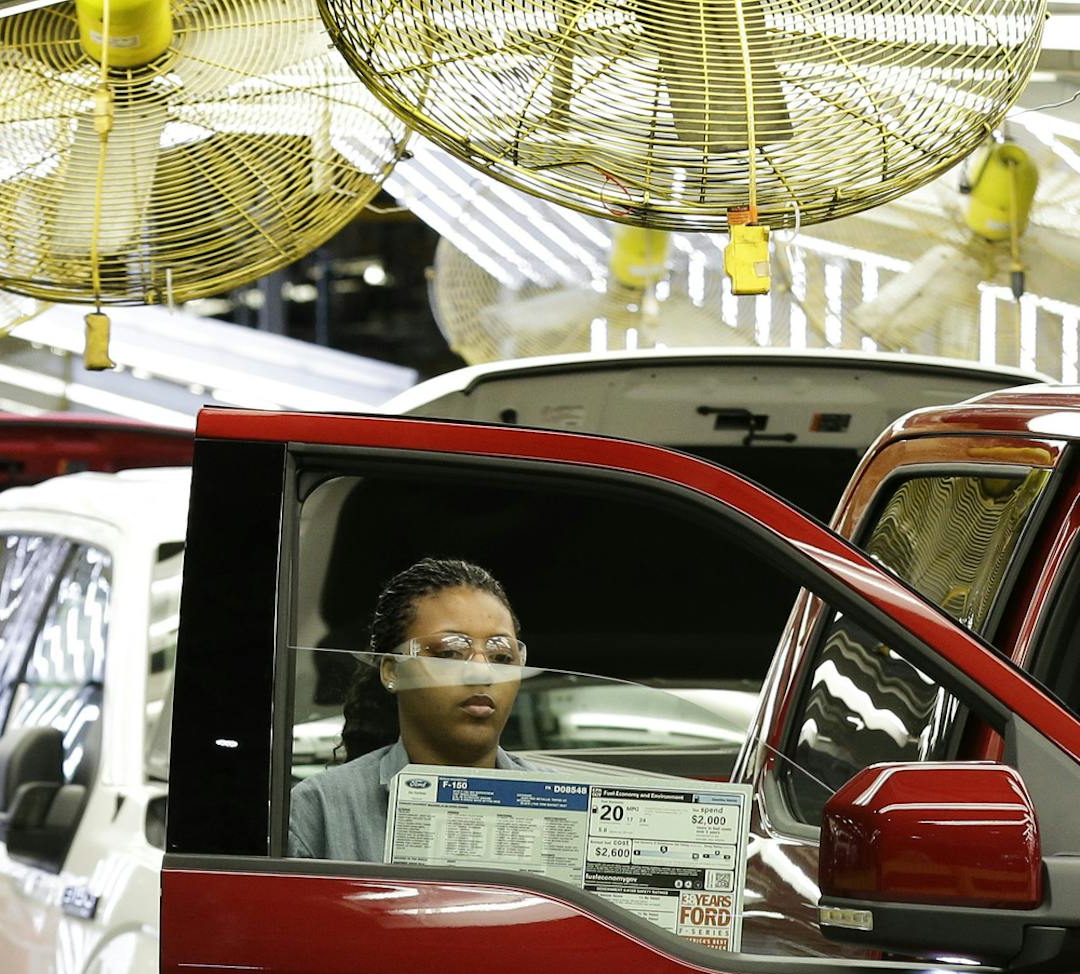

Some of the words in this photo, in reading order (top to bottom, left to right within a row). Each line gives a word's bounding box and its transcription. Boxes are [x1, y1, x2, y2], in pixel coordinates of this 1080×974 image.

[442, 780, 468, 790] F-150
[615, 790, 639, 799] Economy
[600, 804, 624, 822] 20
[700, 807, 724, 815] spend
[691, 815, 726, 825] $2,000
[595, 847, 630, 858] $2,600
[695, 894, 732, 907] YEARS
[680, 906, 731, 927] FORD
